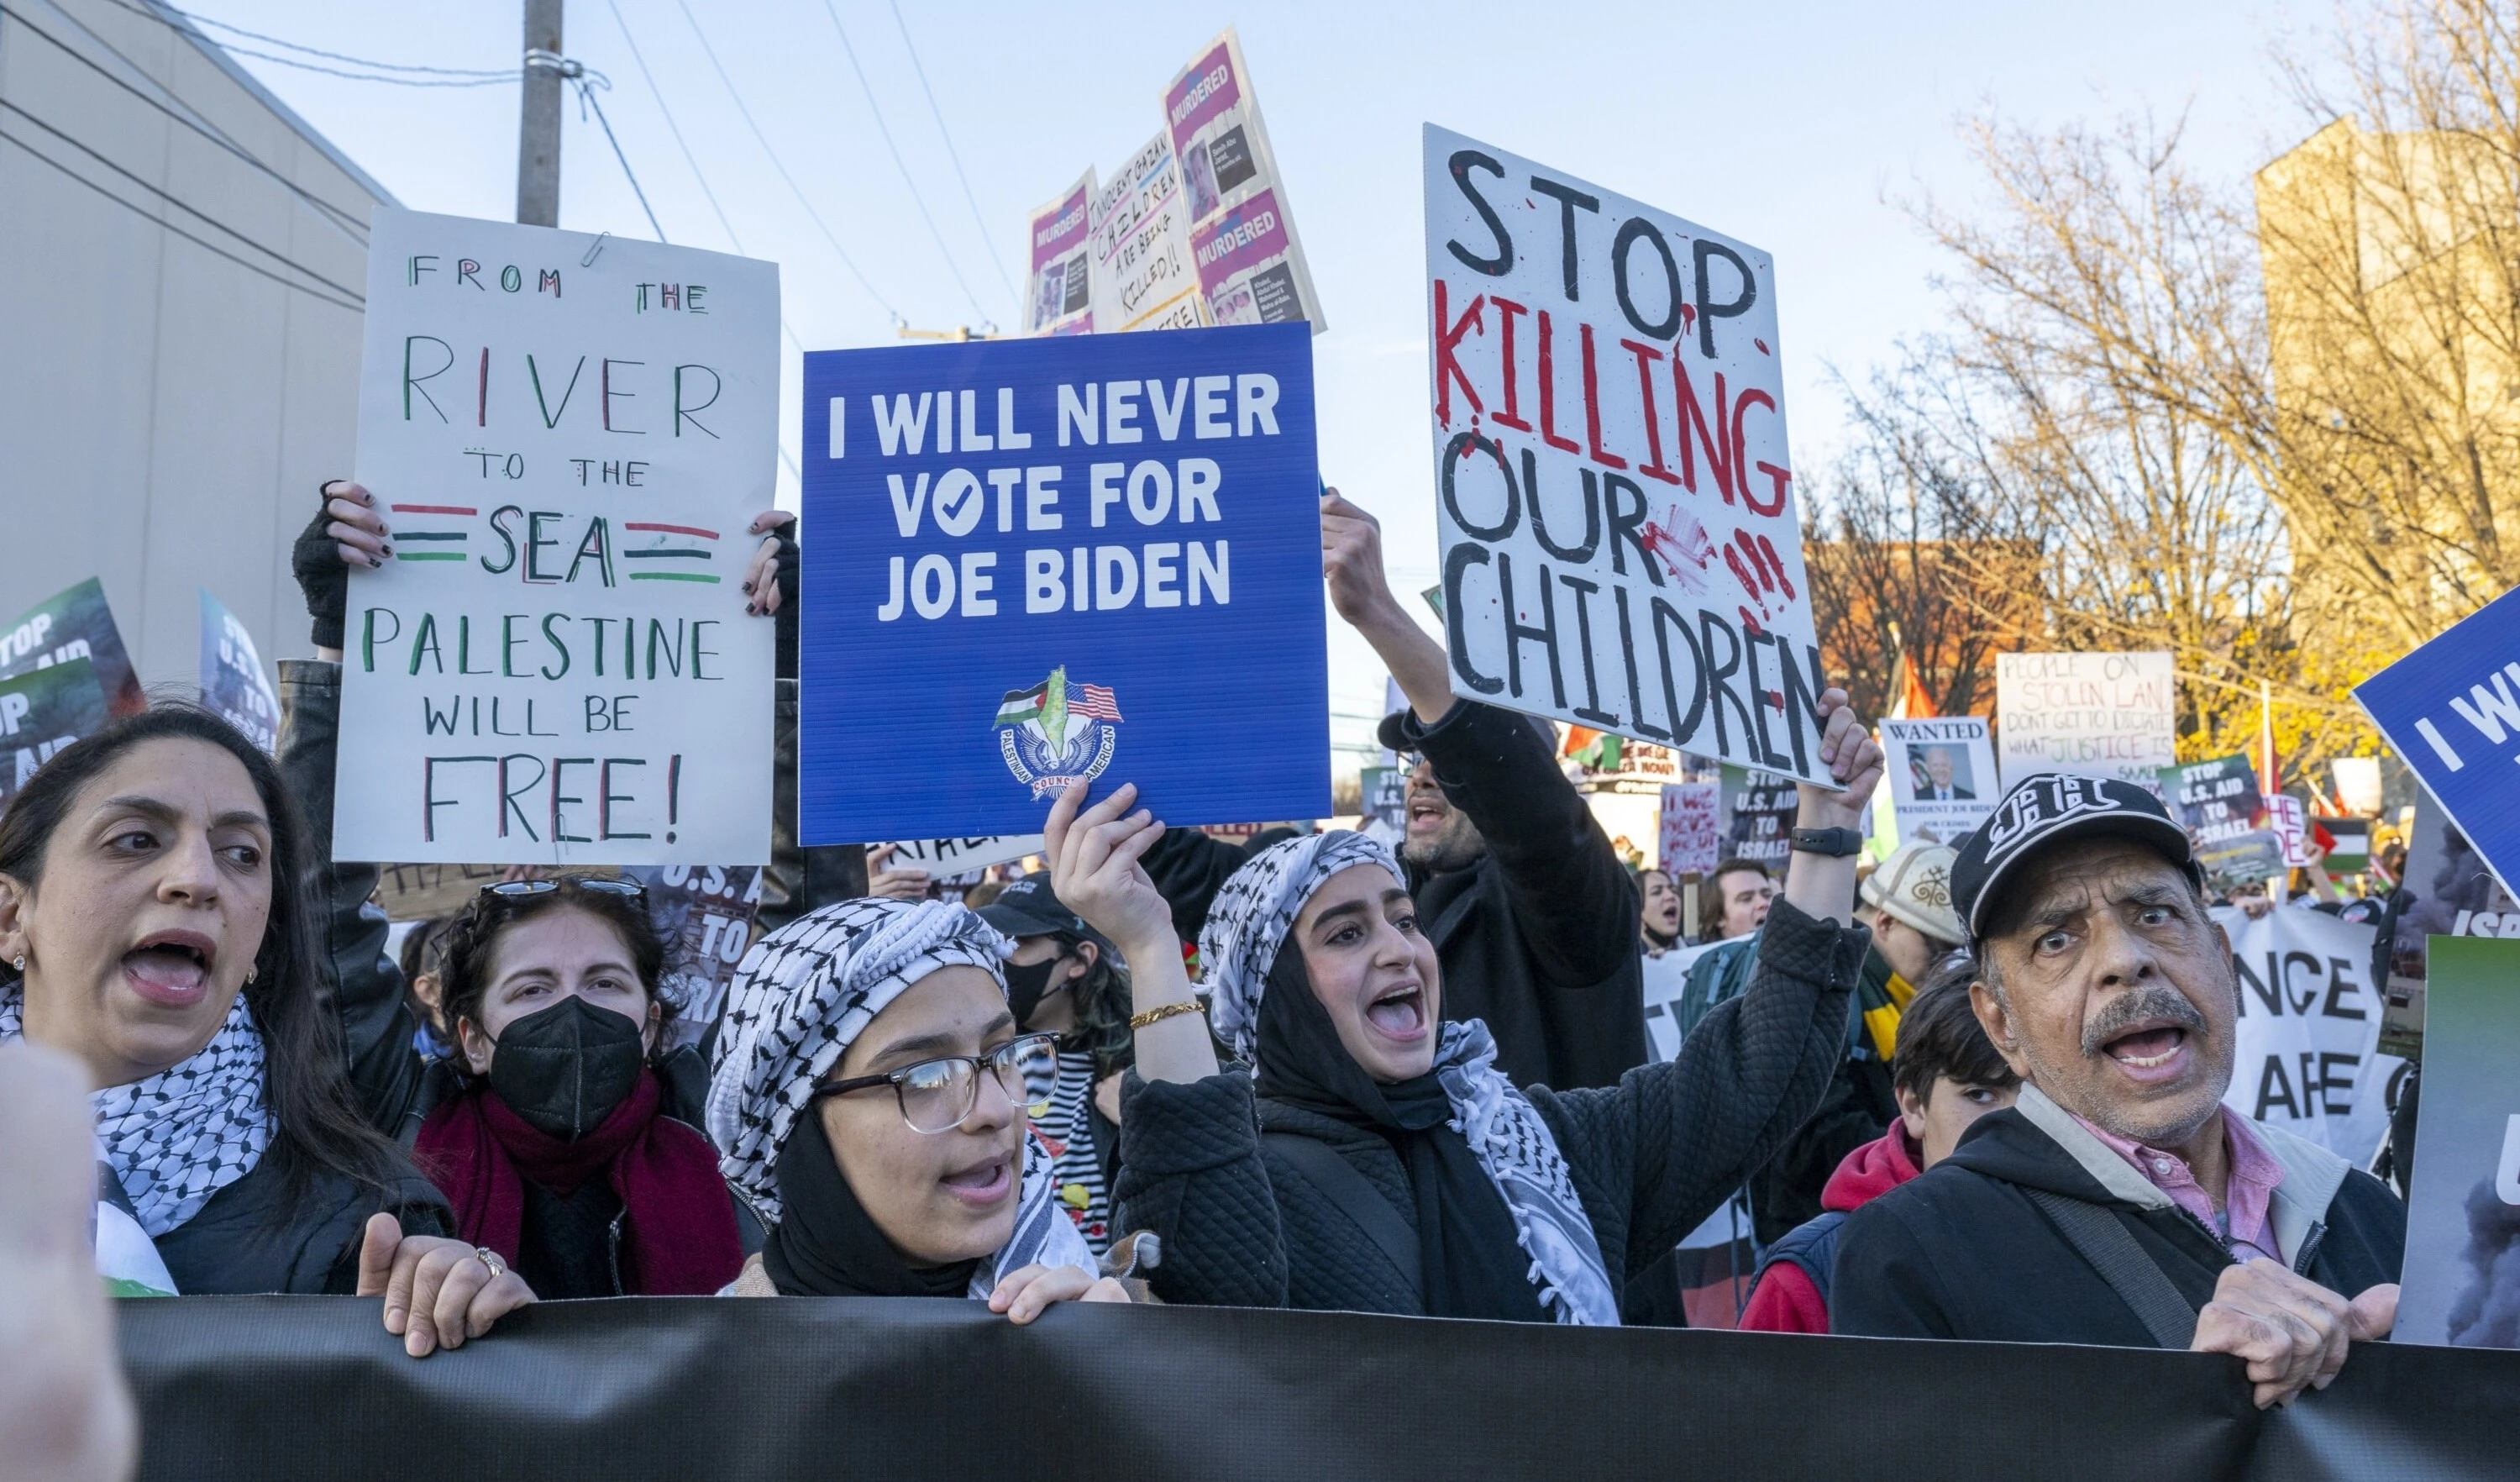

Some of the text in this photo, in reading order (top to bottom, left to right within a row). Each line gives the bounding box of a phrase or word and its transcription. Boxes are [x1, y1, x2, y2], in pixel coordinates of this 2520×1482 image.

[1171, 64, 1229, 127] MURDERED
[1090, 132, 1168, 234] INNOCENT GAZAN
[1037, 203, 1085, 248] MURDERED
[1097, 166, 1175, 261] CHILDREN
[1116, 245, 1136, 280] ARE
[1138, 214, 1171, 255] BEING
[1197, 211, 1276, 268] MURDERED
[1446, 149, 1756, 360] STOP
[409, 256, 709, 314] FROM THE
[1120, 243, 1180, 318] KILLED!!
[403, 336, 721, 439] RIVER
[1434, 279, 1792, 518] KILLING
[829, 373, 1281, 459] I WILL NEVER
[463, 448, 649, 487] TO THE
[887, 458, 1222, 538] VOTE FOR
[1441, 431, 1666, 587] OUR
[480, 505, 616, 587] SEA
[878, 540, 1230, 622] JOE BIDEN
[363, 607, 724, 681] PALESTINE
[1445, 541, 1845, 786] CHILDREN
[2004, 655, 2139, 681] PEOPLE ON
[244, 685, 267, 719] TO
[423, 695, 639, 736] WILL BE
[2021, 675, 2171, 712] STOLEN LAND
[1889, 723, 1983, 741] WANTED
[2053, 712, 2080, 730] GET
[2087, 711, 2107, 728] TO
[2114, 711, 2171, 731] DICTATE
[2414, 717, 2465, 772] I
[1002, 730, 1032, 782] PALESTINIAN
[1085, 727, 1114, 780] AMERICAN
[2008, 733, 2172, 763] WHAT JUSTICE IS
[2181, 762, 2224, 784] STOP
[424, 753, 681, 843] FREE!
[1033, 776, 1075, 791] COUNC
[1374, 789, 1401, 806] U.S.
[1736, 792, 1769, 812] U.S.
[1773, 789, 1798, 810] AID
[1896, 804, 1998, 814] PRESIDENT JOE BIDEN
[2179, 785, 2213, 805] U.S.
[2216, 777, 2244, 797] AID
[1756, 816, 1778, 836] TO
[2204, 801, 2228, 822] TO
[2263, 797, 2301, 828] HE
[1735, 838, 1792, 860] ISRAEL
[662, 865, 735, 899] U.S.
[699, 913, 749, 964] TO
